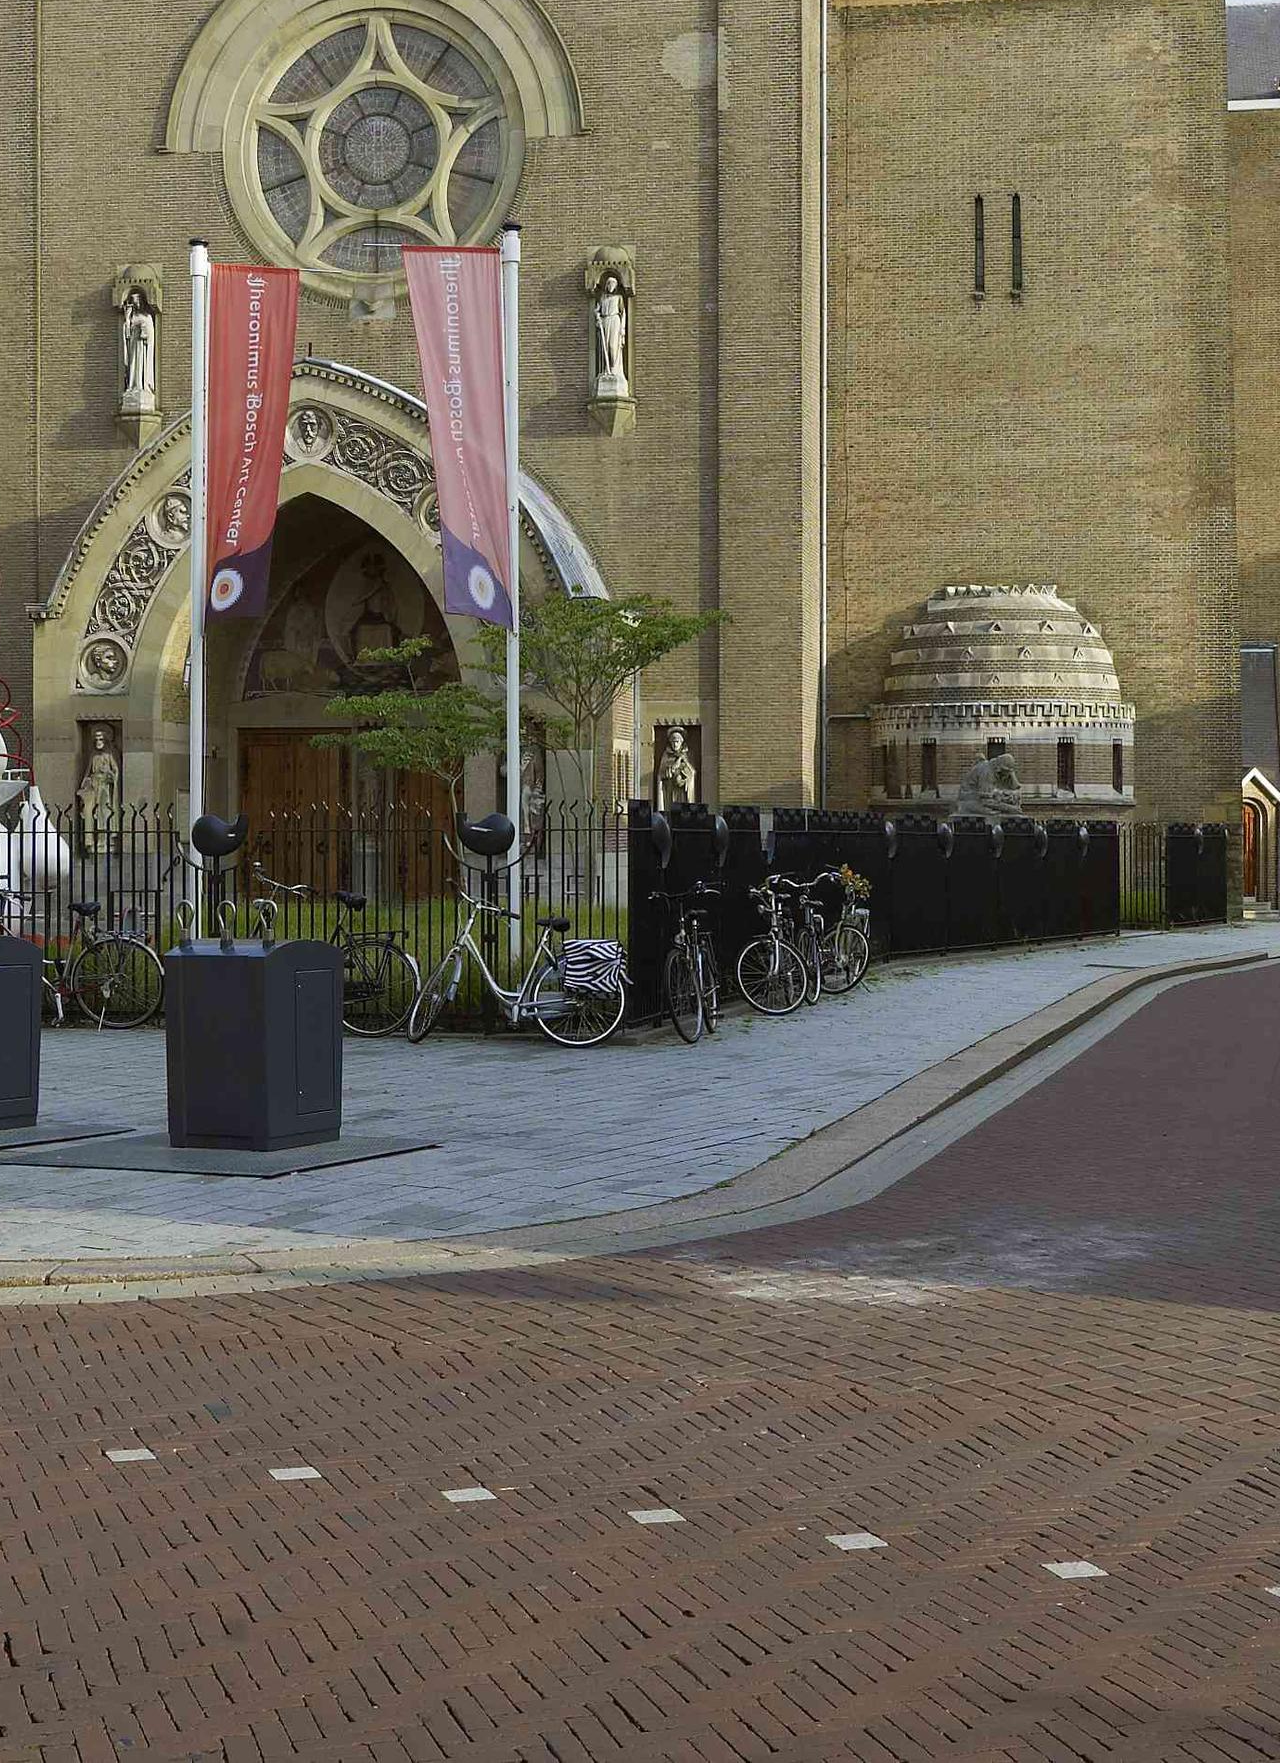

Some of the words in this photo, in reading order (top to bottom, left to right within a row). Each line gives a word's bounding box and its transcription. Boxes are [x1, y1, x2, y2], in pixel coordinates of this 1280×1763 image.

[246, 273, 268, 389] Jheronimus
[244, 392, 264, 453] Bosch
[238, 457, 253, 483] Art
[226, 485, 247, 546] Center
